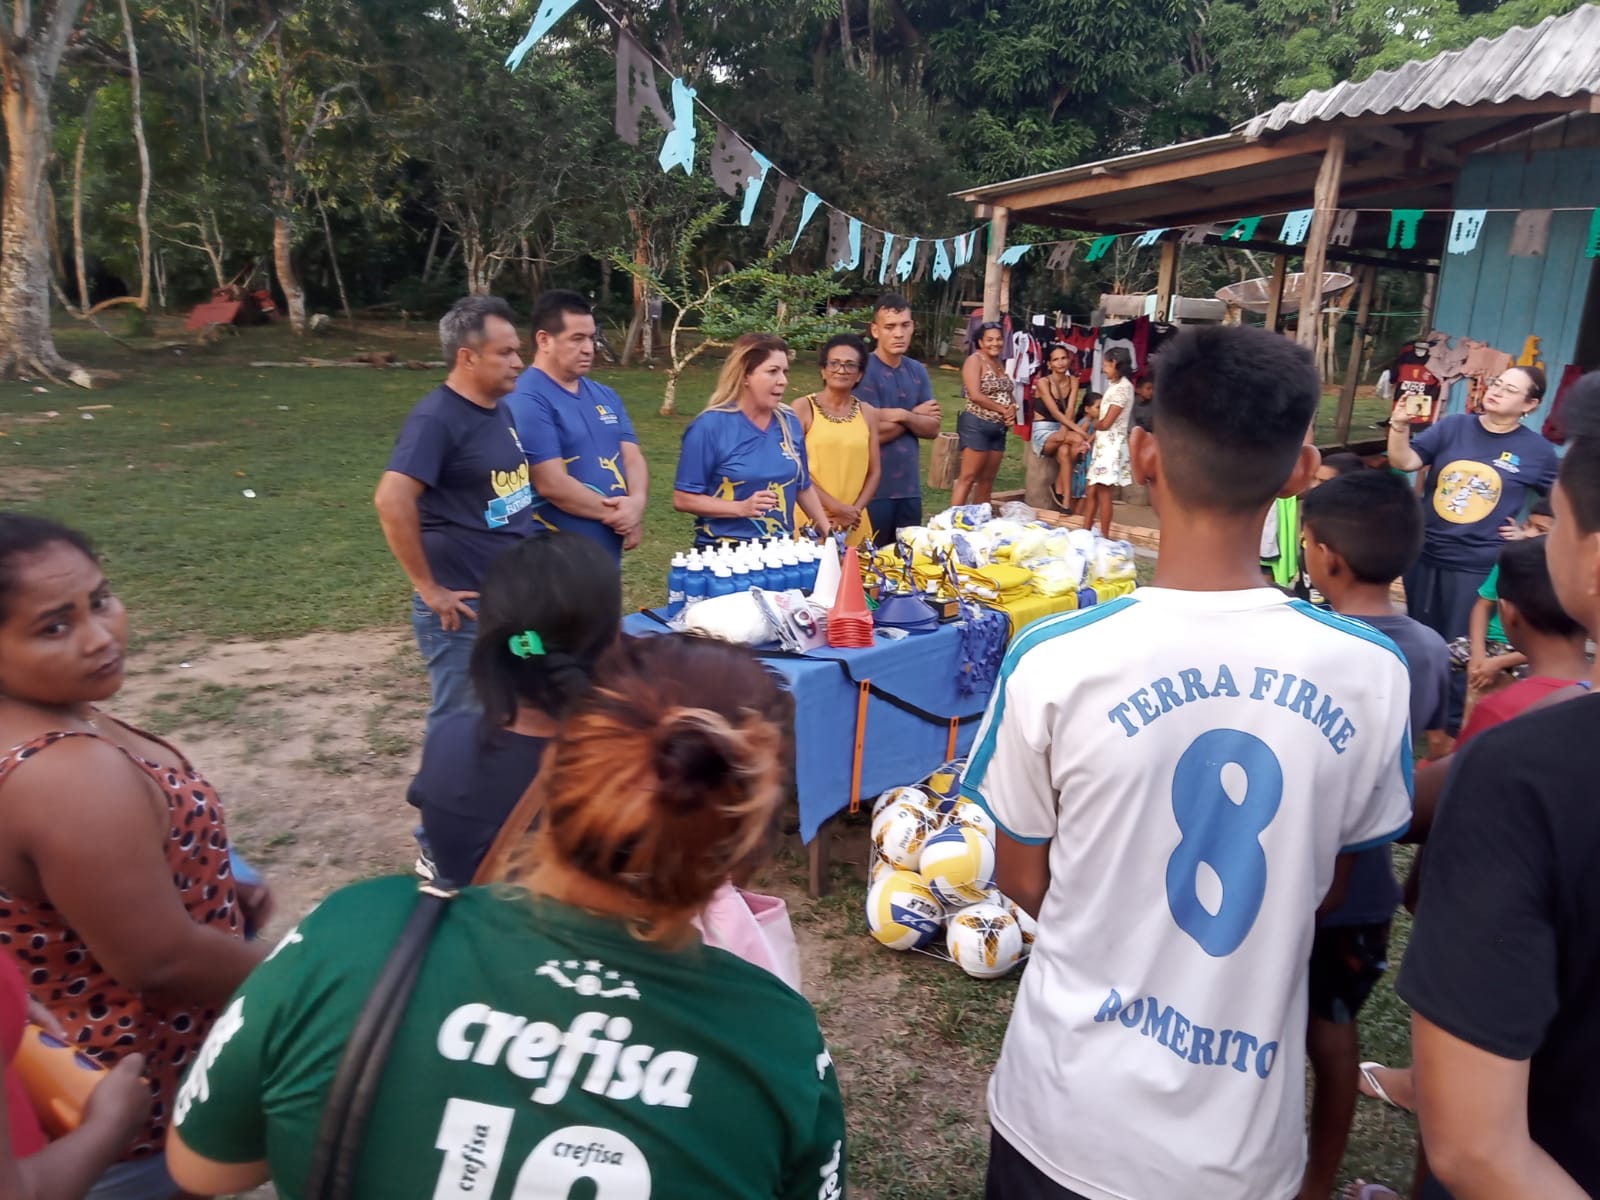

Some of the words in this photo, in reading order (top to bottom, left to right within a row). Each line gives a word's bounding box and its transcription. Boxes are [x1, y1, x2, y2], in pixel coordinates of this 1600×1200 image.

[1108, 664, 1238, 737] TERRA
[1249, 666, 1356, 755] FIRME
[1166, 728, 1282, 957] 8
[436, 1002, 699, 1108] crefisa
[1094, 988, 1279, 1079] ROMERITO
[459, 1125, 490, 1191] crefisa
[552, 1141, 623, 1168] crefisa
